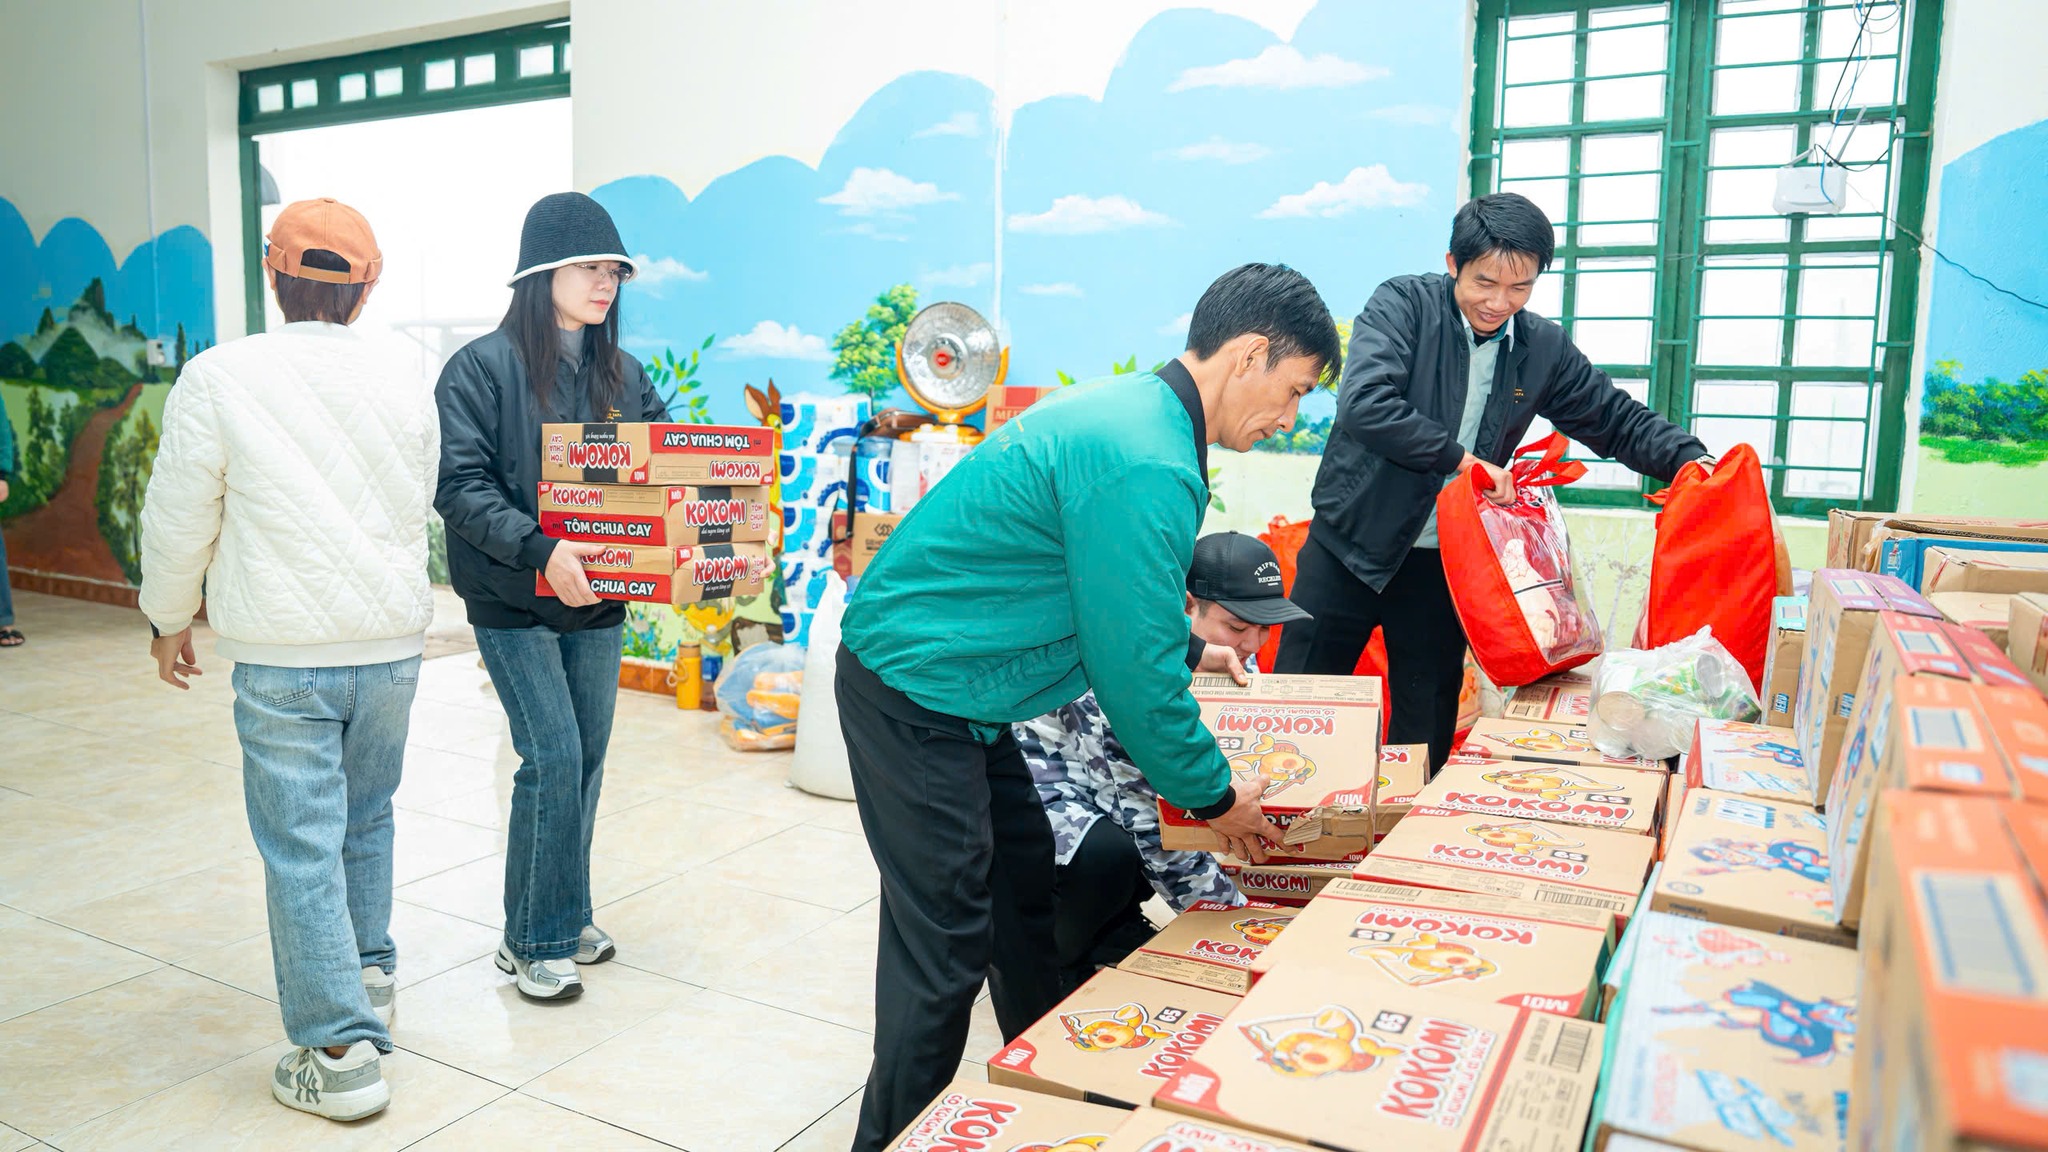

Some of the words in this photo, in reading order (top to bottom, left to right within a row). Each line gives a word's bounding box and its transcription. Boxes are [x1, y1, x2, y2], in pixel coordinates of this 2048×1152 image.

[664, 432, 688, 446] CAY
[690, 434, 723, 447] CHUA
[724, 435, 750, 450] TÔM
[568, 442, 632, 468] KOKOMI
[710, 462, 761, 480] KOKOMI
[552, 488, 604, 506] KOKOMI
[684, 500, 746, 527] KOKOMI
[564, 517, 590, 534] TÔM
[592, 522, 626, 536] CHUA
[627, 524, 652, 537] CAY
[692, 555, 749, 586] KOKOMI
[590, 579, 626, 594] CHUA
[628, 581, 656, 596] CAY
[1217, 714, 1334, 735] KOKOMI
[1218, 738, 1242, 748] 65
[1445, 792, 1630, 819] KOKOMI
[1590, 794, 1627, 804] 65
[1461, 806, 1512, 814] KOKOMI
[1434, 844, 1586, 876] KOKOMI
[1553, 851, 1584, 862] 65
[1242, 872, 1311, 892] KOKOMI
[1357, 930, 1390, 940] 65
[1360, 912, 1534, 944] KOKOMI
[1195, 939, 1263, 961] KOK
[1203, 952, 1239, 964] KOKOMI
[1158, 1008, 1182, 1022] 65
[1375, 1012, 1407, 1032] 65
[1140, 1013, 1224, 1079] KOKOMI
[1381, 1020, 1470, 1118] KOKOMI
[917, 1107, 953, 1137] KOKOMI
